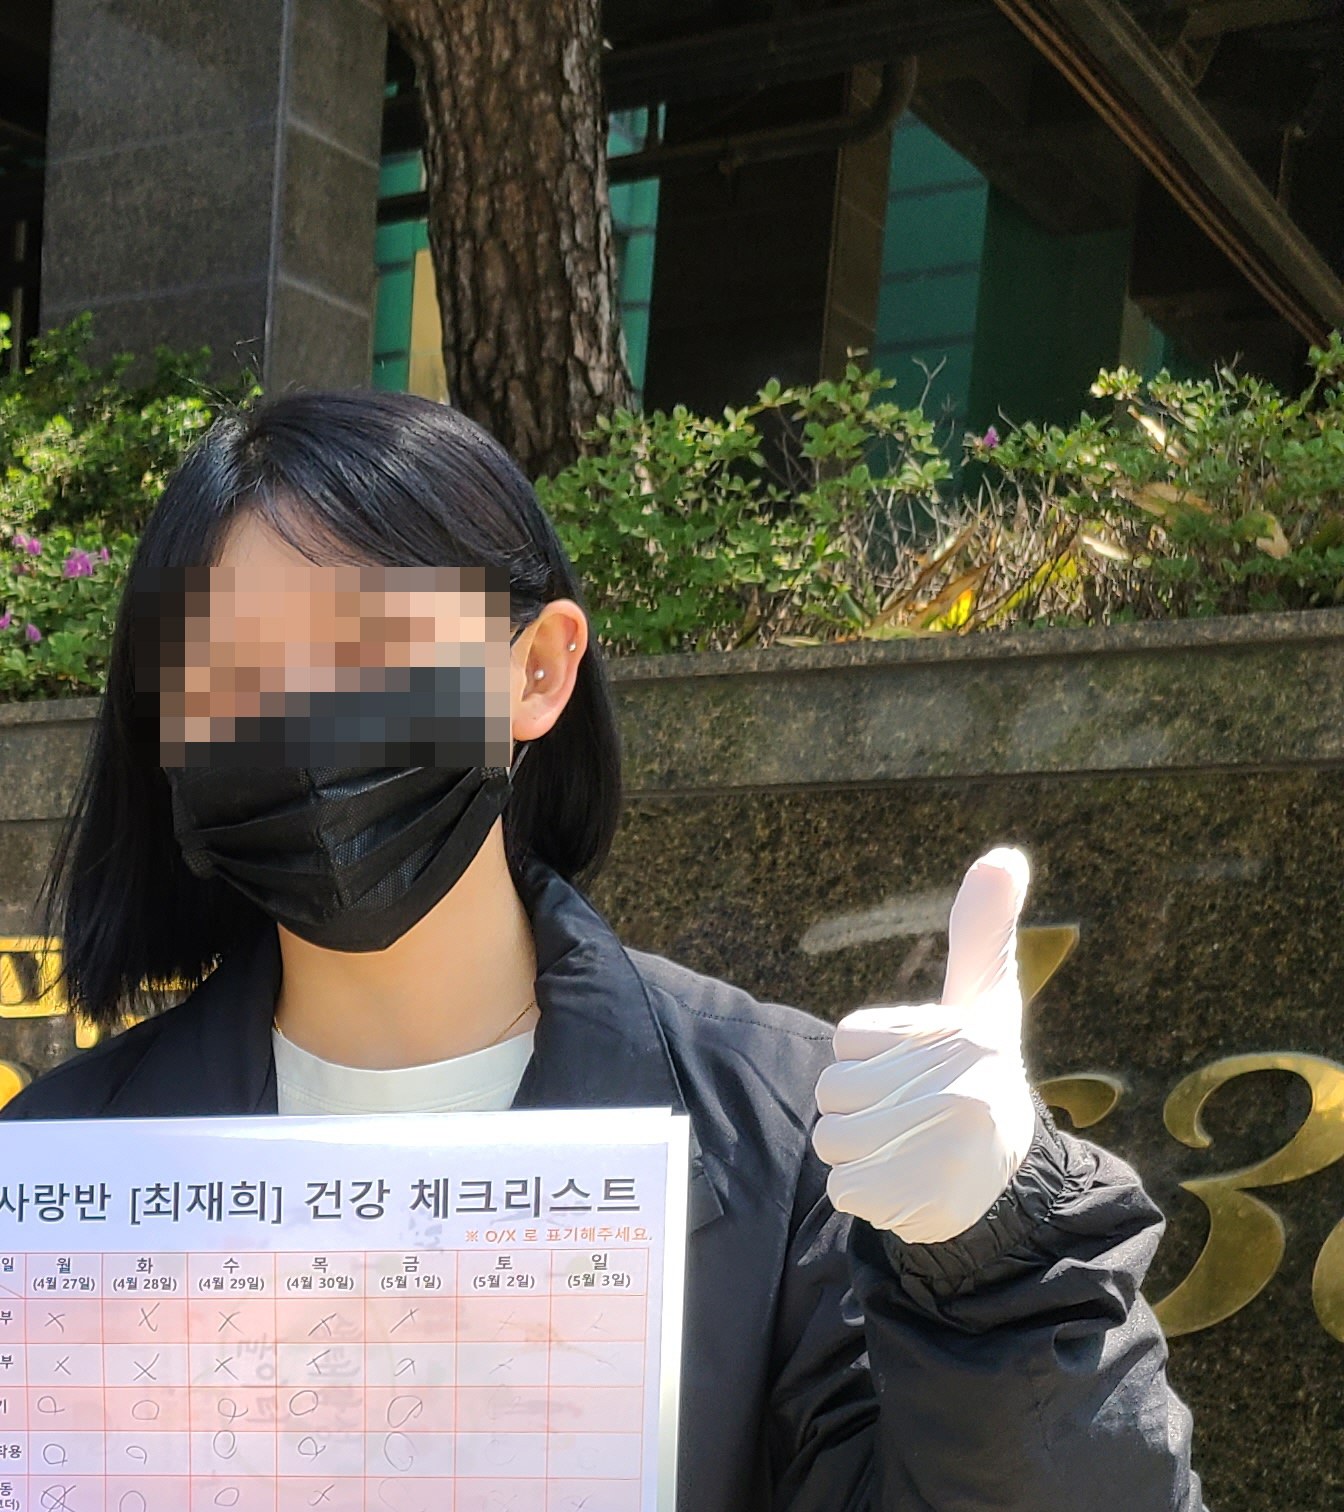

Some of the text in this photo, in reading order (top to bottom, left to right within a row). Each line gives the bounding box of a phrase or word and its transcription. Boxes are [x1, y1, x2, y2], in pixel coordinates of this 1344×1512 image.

[129, 1180, 283, 1225] [최재희]
[304, 1178, 391, 1220] 건강
[408, 1176, 641, 1220] 체크리스트
[523, 1229, 538, 1242] 로
[546, 1226, 653, 1243] 표기해주세요.
[56, 1257, 71, 1274] 월
[136, 1257, 153, 1274] 화
[223, 1257, 240, 1274] 수
[312, 1256, 329, 1273] 목
[402, 1255, 420, 1272] 금
[495, 1256, 513, 1271] 토
[591, 1253, 608, 1271] 일
[33, 1276, 96, 1292] (4월 27일)
[112, 1276, 178, 1292] (4월 28일)
[198, 1276, 264, 1291] (4월 29일)
[286, 1275, 354, 1290] (4월 30일)
[380, 1275, 442, 1290] (5월 1일)
[473, 1274, 536, 1289] (5월 2일)
[567, 1273, 631, 1288] (5월 3일)
